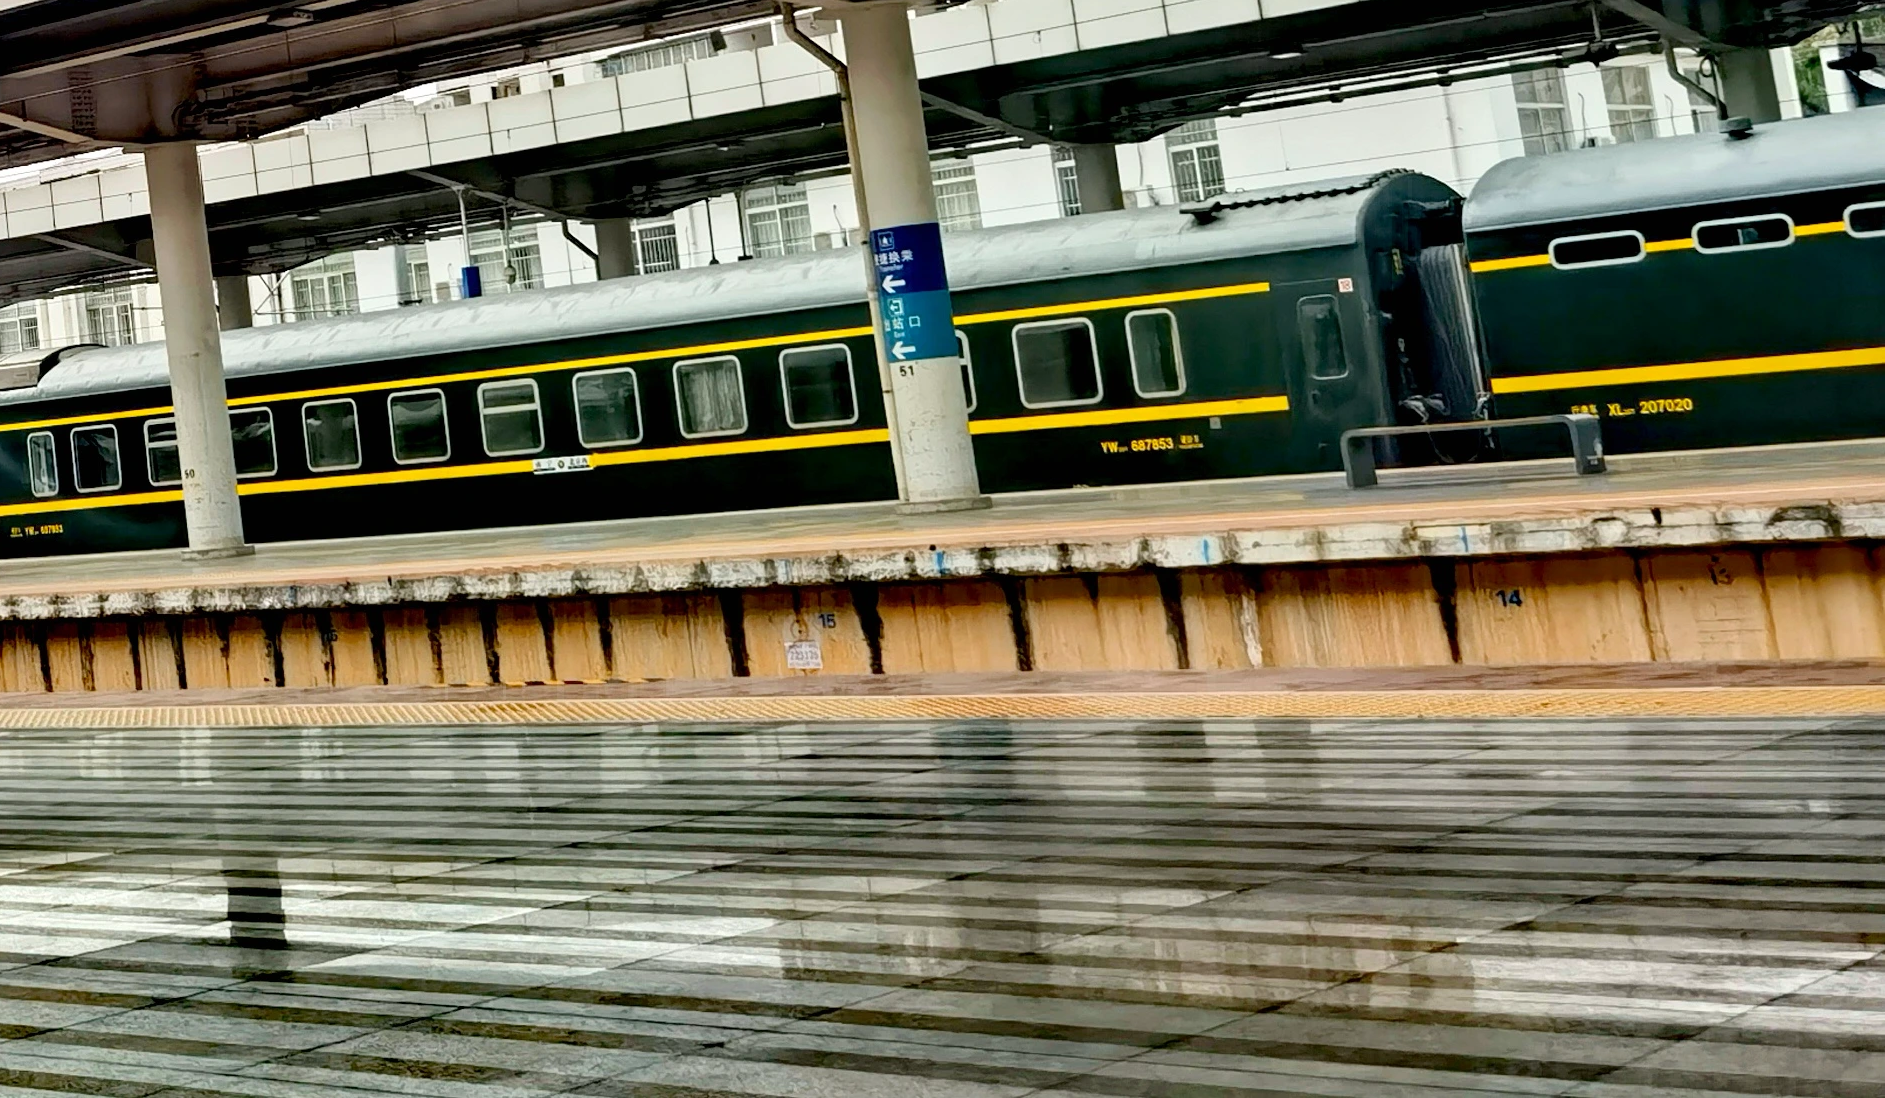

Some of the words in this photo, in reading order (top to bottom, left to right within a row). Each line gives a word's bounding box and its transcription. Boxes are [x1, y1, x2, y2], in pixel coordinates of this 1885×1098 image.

[899, 365, 915, 377] 51
[1639, 397, 1694, 415] 207020
[1130, 437, 1174, 452] 687853
[184, 468, 195, 479] 50
[1495, 589, 1523, 607] 14
[818, 613, 836, 628] 15
